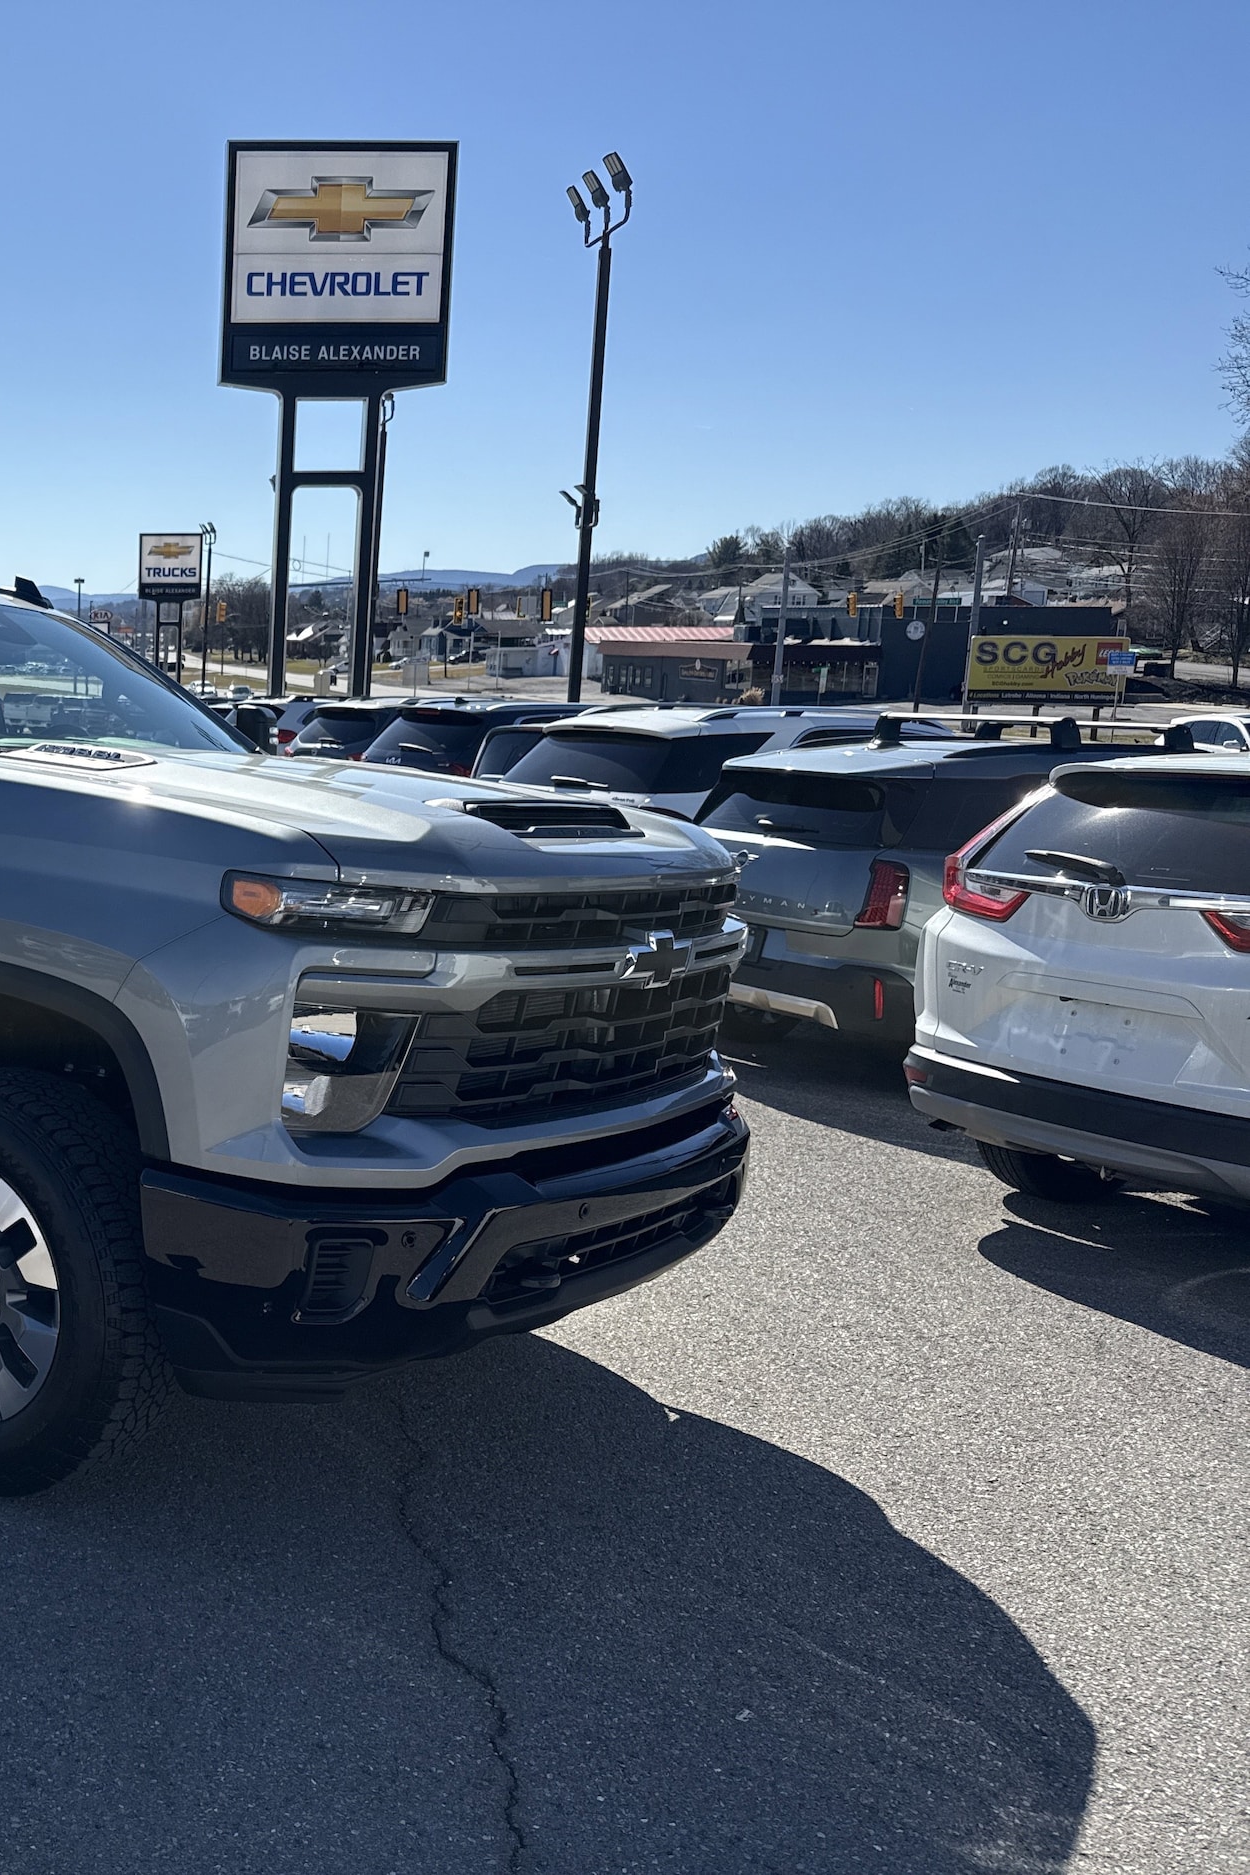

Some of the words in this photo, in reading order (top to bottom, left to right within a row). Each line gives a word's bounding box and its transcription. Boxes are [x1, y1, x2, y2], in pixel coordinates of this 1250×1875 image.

[246, 271, 430, 297] CHEVROLET
[249, 345, 311, 361] BLAISE
[317, 345, 421, 361] ALEXANDER
[144, 567, 197, 578] TRUCKS
[93, 610, 109, 619] KIA
[975, 640, 1058, 666] SCG
